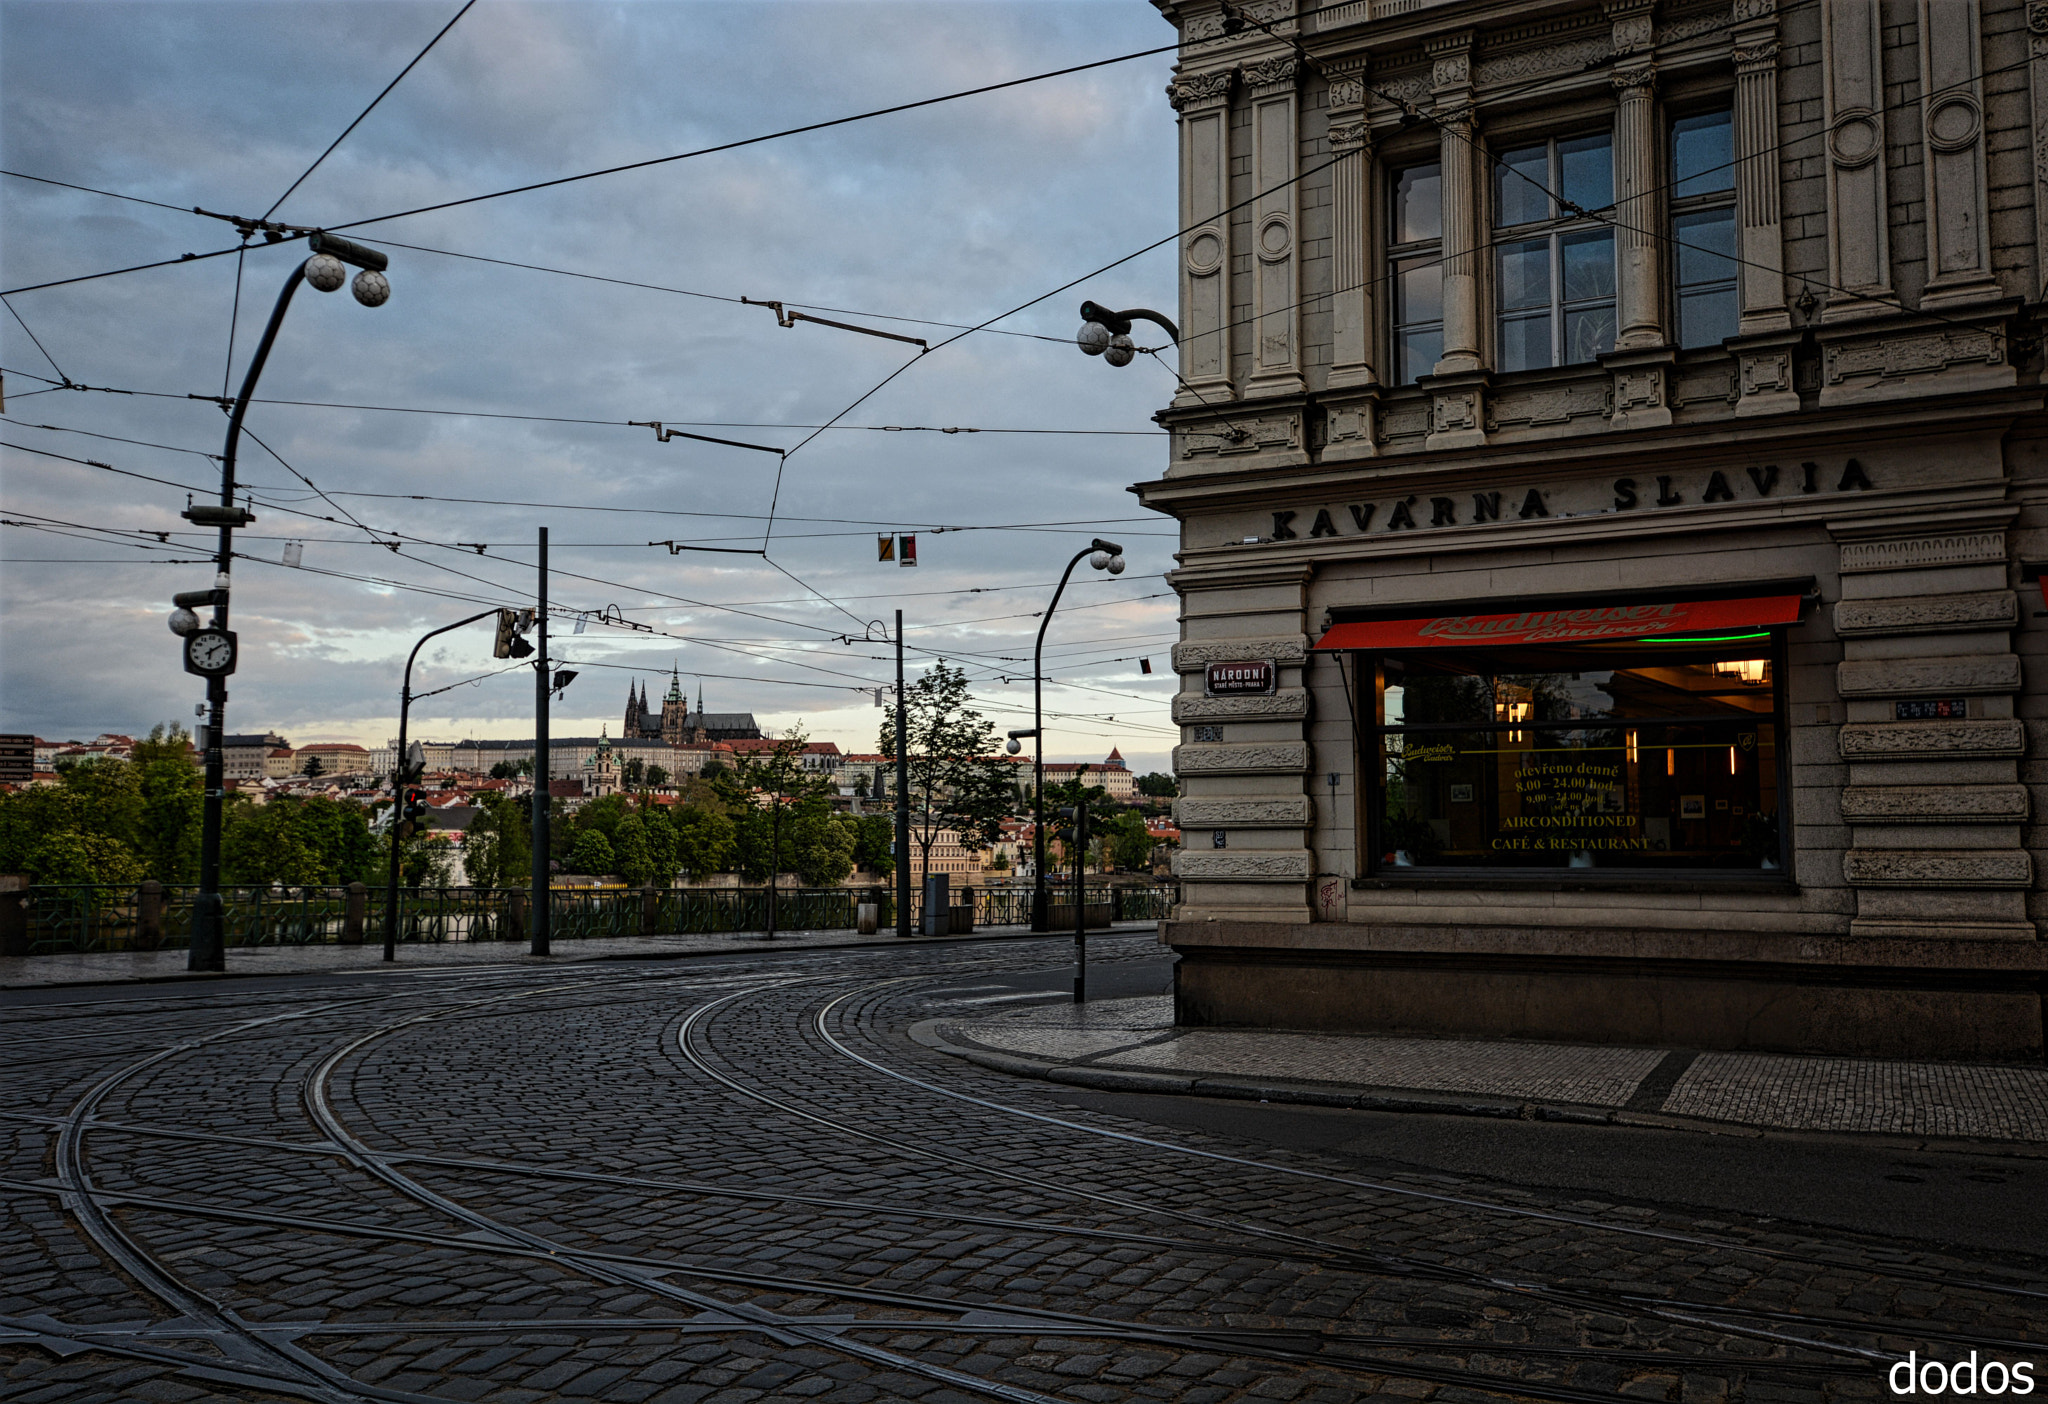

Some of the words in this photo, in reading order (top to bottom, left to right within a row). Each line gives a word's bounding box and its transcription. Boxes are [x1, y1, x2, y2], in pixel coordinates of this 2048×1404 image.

[1272, 488, 1549, 539] KAVÁRNA
[1614, 458, 1872, 508] SLAVIA
[1523, 621, 1677, 641] Budvar
[1213, 666, 1265, 681] NÁRODNÍ
[1514, 764, 1573, 778] otevřeno
[1576, 762, 1620, 777] denně
[1503, 815, 1637, 828] AIRCONDITIONED
[1491, 835, 1531, 850] CAFÉ
[1534, 838, 1545, 850] &
[1550, 837, 1651, 850] RESTAURANT
